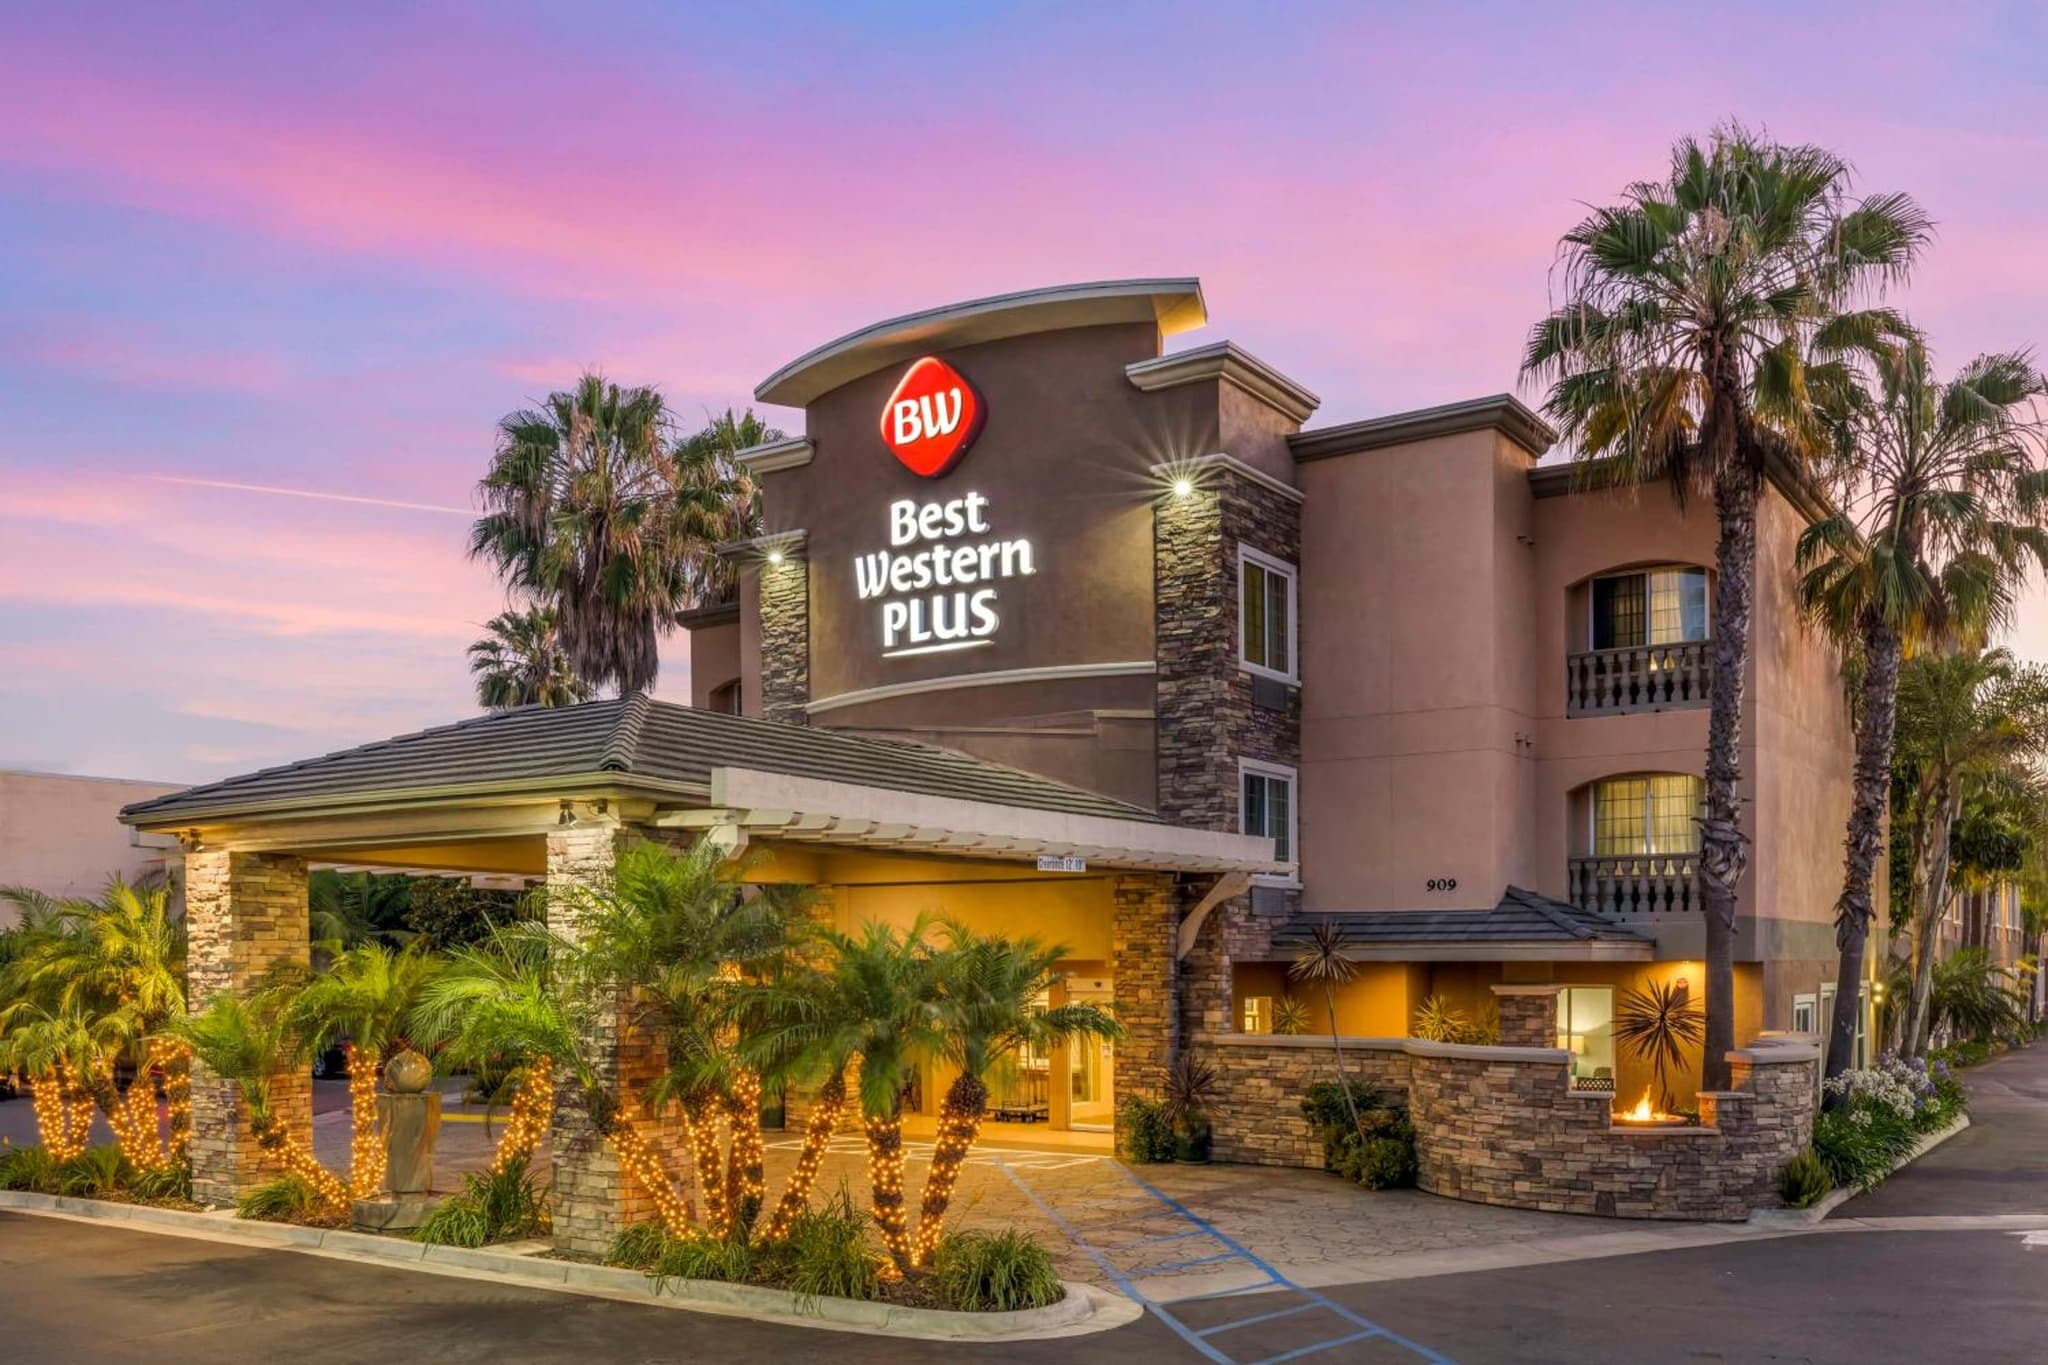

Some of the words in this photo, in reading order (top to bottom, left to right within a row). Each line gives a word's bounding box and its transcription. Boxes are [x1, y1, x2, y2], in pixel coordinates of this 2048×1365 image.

[893, 387, 963, 445] BW
[890, 491, 988, 546] Best
[855, 538, 1034, 600] Western
[882, 588, 998, 648] PLUS
[1426, 878, 1457, 892] 909
